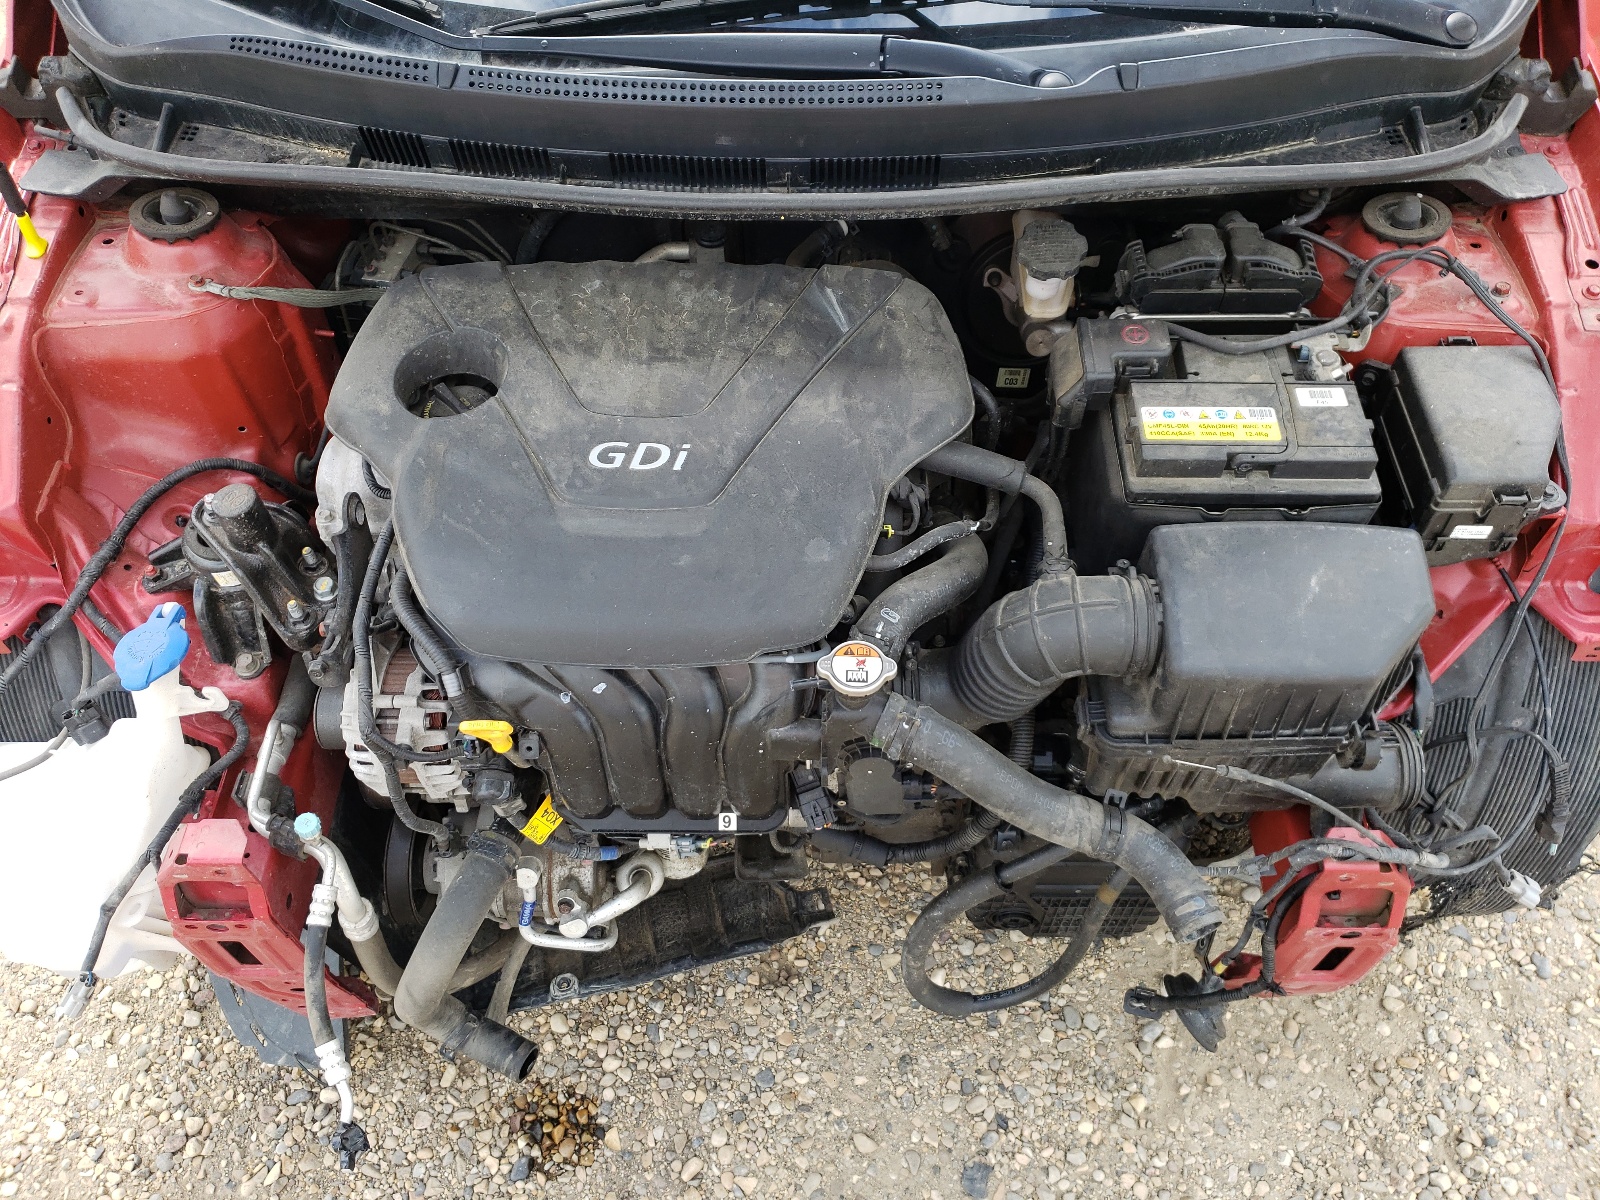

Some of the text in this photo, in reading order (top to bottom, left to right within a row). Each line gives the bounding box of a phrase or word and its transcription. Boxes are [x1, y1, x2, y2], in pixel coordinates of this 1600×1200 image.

[1004, 377, 1018, 386] C03
[588, 441, 691, 471] GDi
[540, 807, 561, 826] X04
[722, 814, 732, 829] 9
